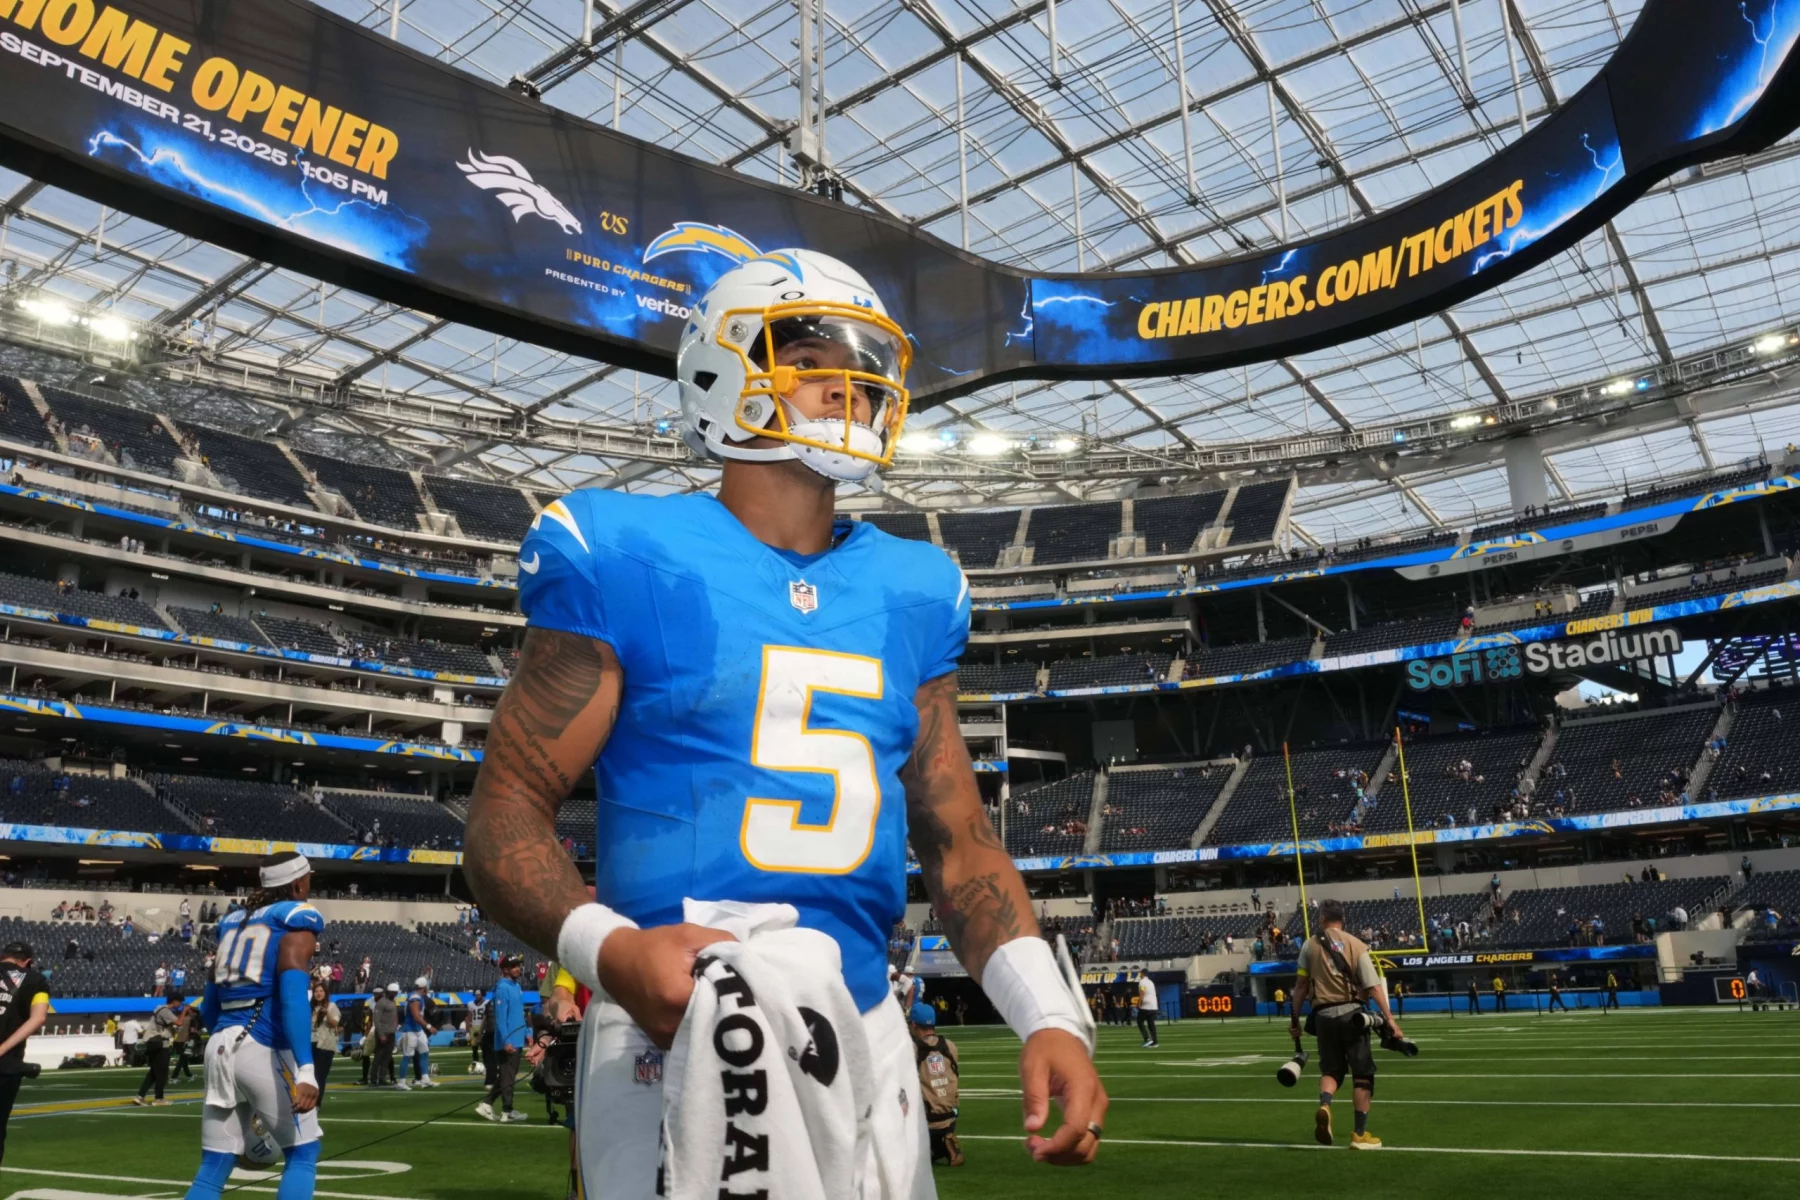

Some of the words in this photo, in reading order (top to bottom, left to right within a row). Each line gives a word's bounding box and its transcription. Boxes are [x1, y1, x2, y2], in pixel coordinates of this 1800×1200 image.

[0, 32, 180, 124] SEPTEMBER
[183, 113, 215, 141] 21,
[219, 129, 287, 166] 2025
[301, 160, 348, 189] 1:05
[351, 179, 388, 204] PM
[192, 57, 399, 180] OPENER
[573, 251, 611, 271] PURO
[612, 264, 685, 292] CHARGERS
[1137, 179, 1523, 339] CHARGERS.COM/TICKETS
[545, 268, 608, 293] PRESENTED
[612, 288, 626, 298] BY
[636, 294, 693, 320] verizo
[1621, 523, 1658, 539] PEPSI
[1483, 552, 1518, 566] PEPSI
[1566, 614, 1624, 636] CHARGERS
[1629, 608, 1653, 625] WIN
[1407, 653, 1481, 690] SoFi
[1525, 629, 1681, 673] Stadium
[740, 644, 882, 875] 5
[1154, 849, 1197, 863] CHARGERS
[1199, 848, 1218, 861] WIN
[1403, 957, 1422, 966] LOS
[1425, 955, 1473, 967] ANGELES
[1476, 952, 1533, 963] CHARGERS
[1081, 973, 1102, 984] BOLT
[1103, 973, 1117, 983] UP
[1731, 979, 1744, 999] 0
[472, 1009, 485, 1020] 15
[1198, 996, 1232, 1012] 0:00
